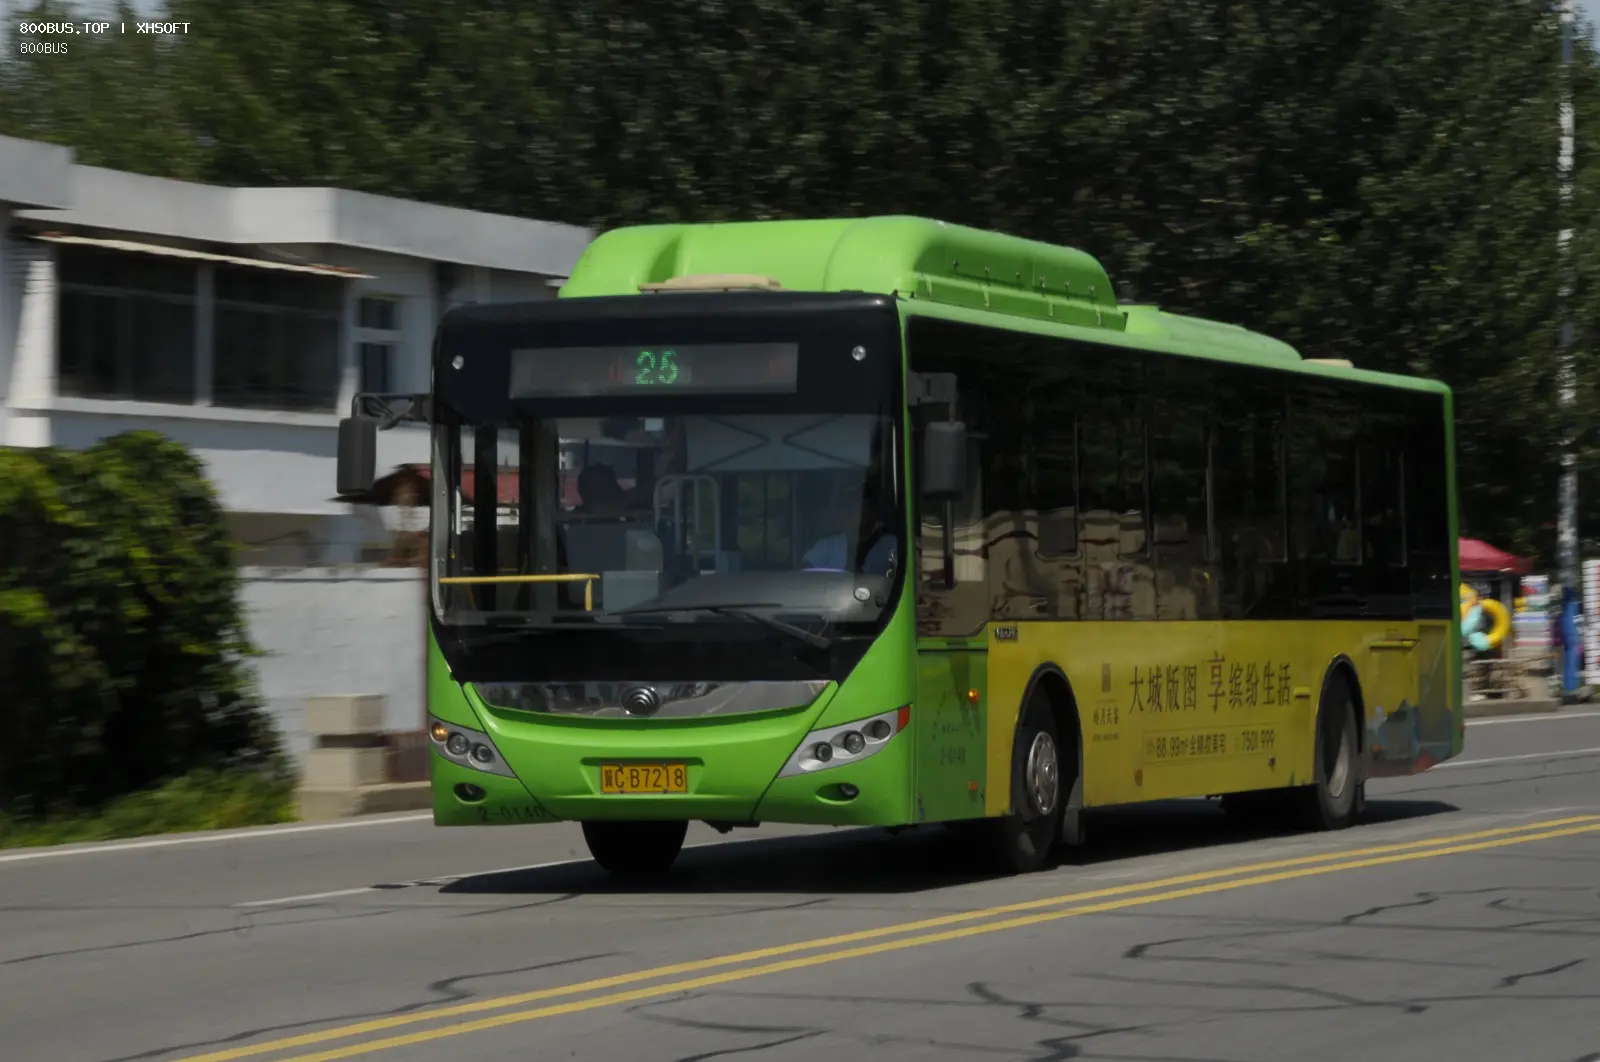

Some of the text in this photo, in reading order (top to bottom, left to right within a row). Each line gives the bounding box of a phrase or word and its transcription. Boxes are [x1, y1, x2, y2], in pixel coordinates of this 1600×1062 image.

[635, 351, 677, 385] 25
[1128, 652, 1291, 715] 大城版图 享缤纷生活
